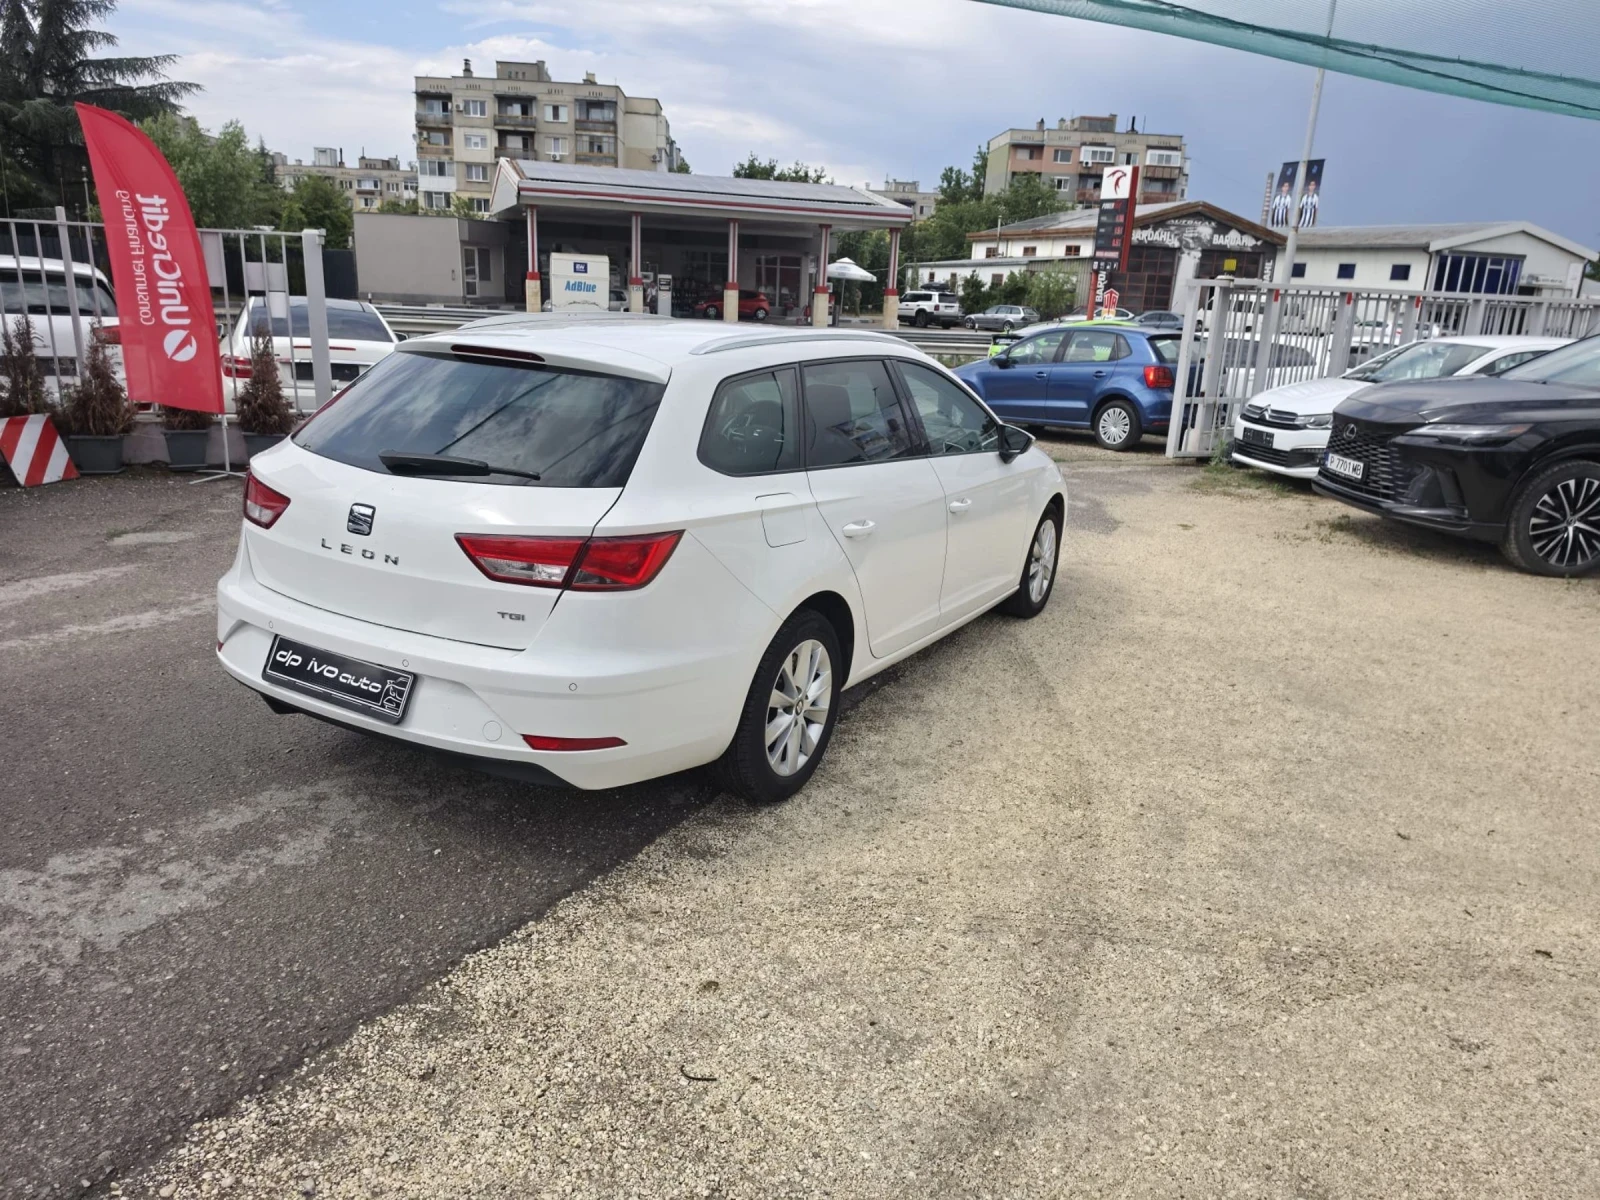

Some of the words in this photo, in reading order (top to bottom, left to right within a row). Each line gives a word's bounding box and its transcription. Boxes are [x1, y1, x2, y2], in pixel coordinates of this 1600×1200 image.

[564, 280, 597, 293] AdBlue
[1096, 271, 1107, 302] BARD
[320, 538, 400, 566] LEON
[497, 611, 526, 621] TGI
[275, 650, 302, 667] dp
[306, 657, 339, 678] ivo
[338, 673, 382, 693] auto
